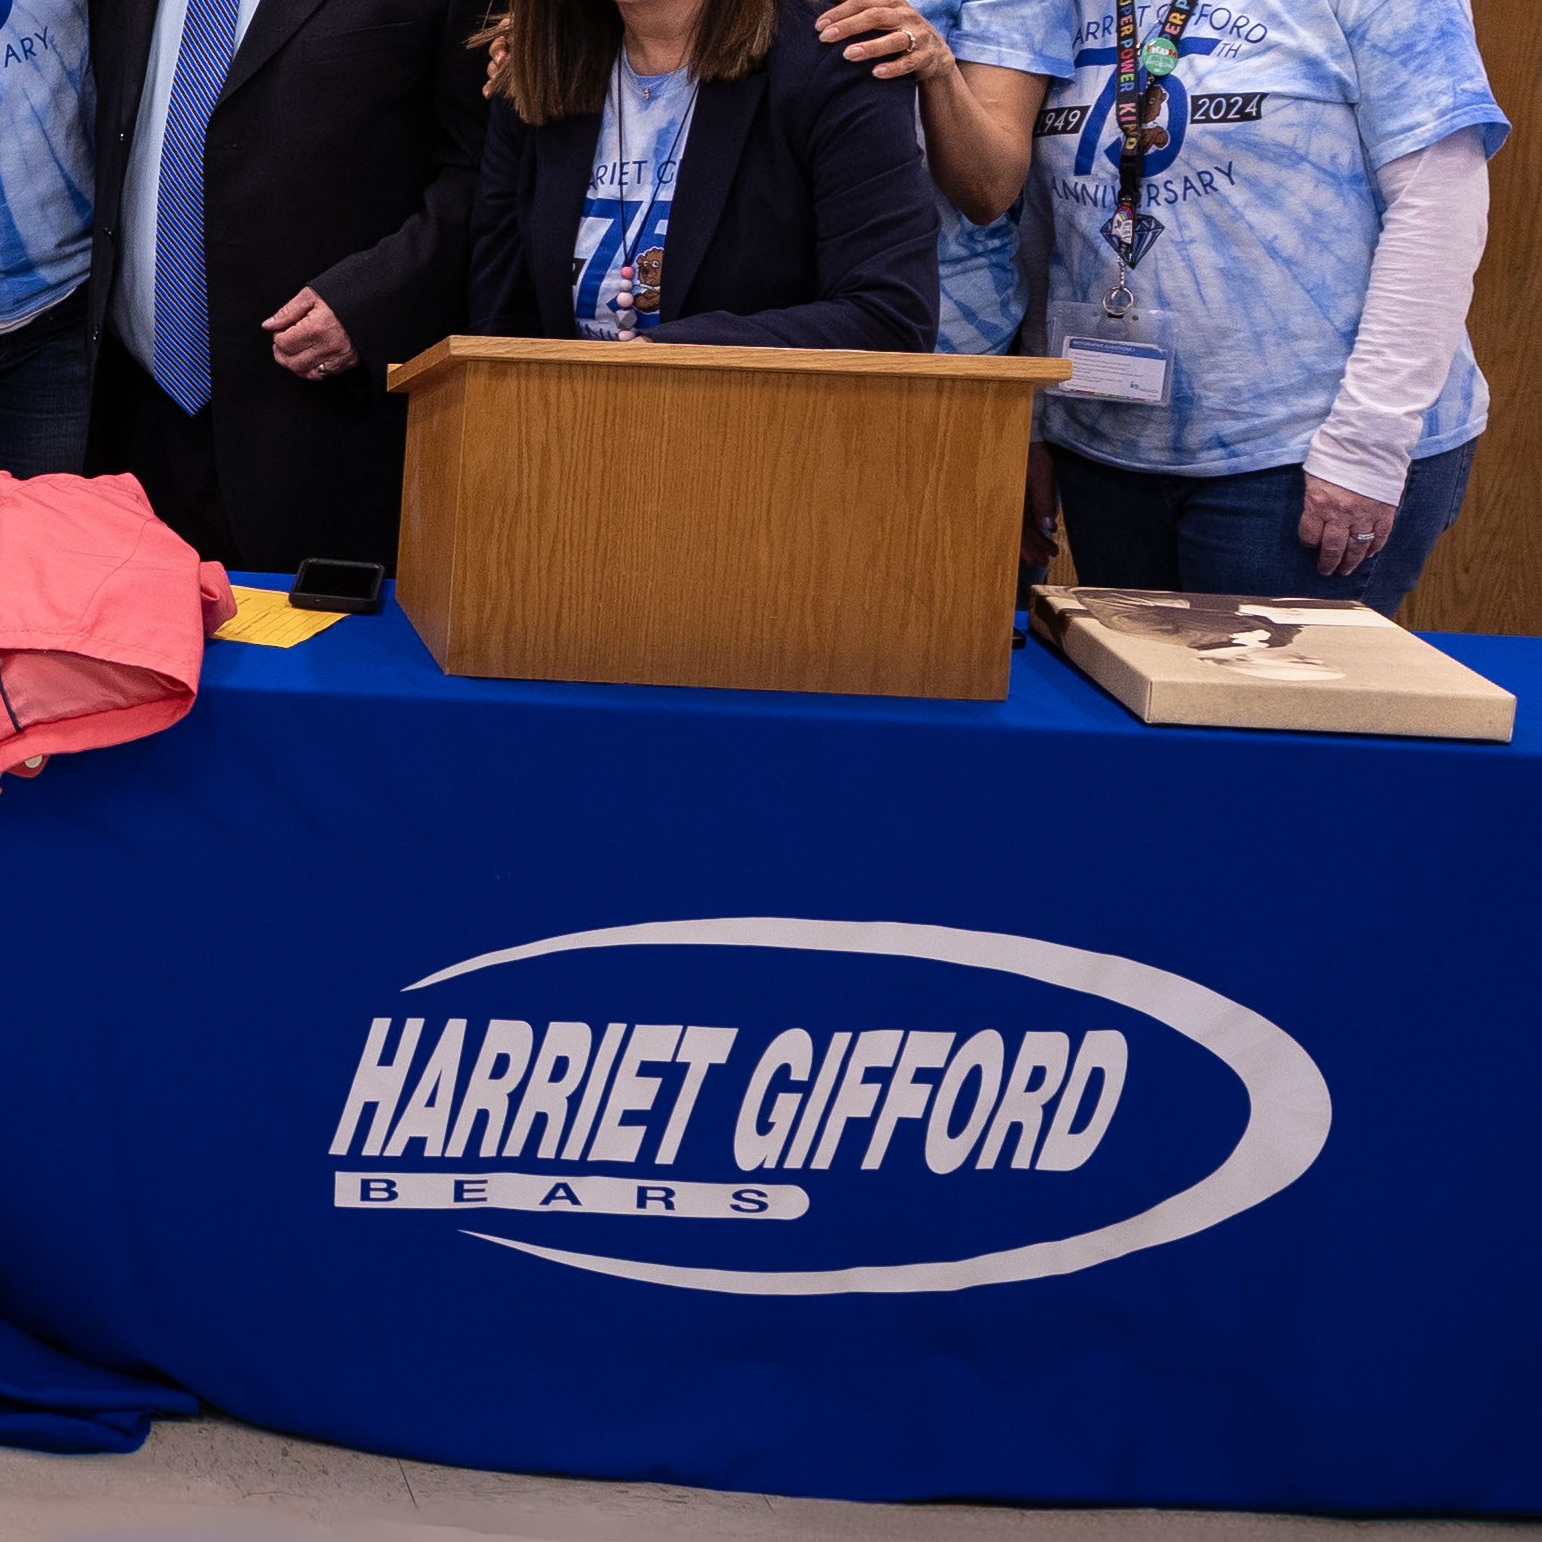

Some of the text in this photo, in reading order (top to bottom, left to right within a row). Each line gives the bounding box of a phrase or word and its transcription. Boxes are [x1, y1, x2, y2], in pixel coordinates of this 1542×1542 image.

[1192, 94, 1259, 122] 2024
[328, 1015, 1130, 1176] HARRIET GIFFORD
[358, 1177, 772, 1216] BEARS
